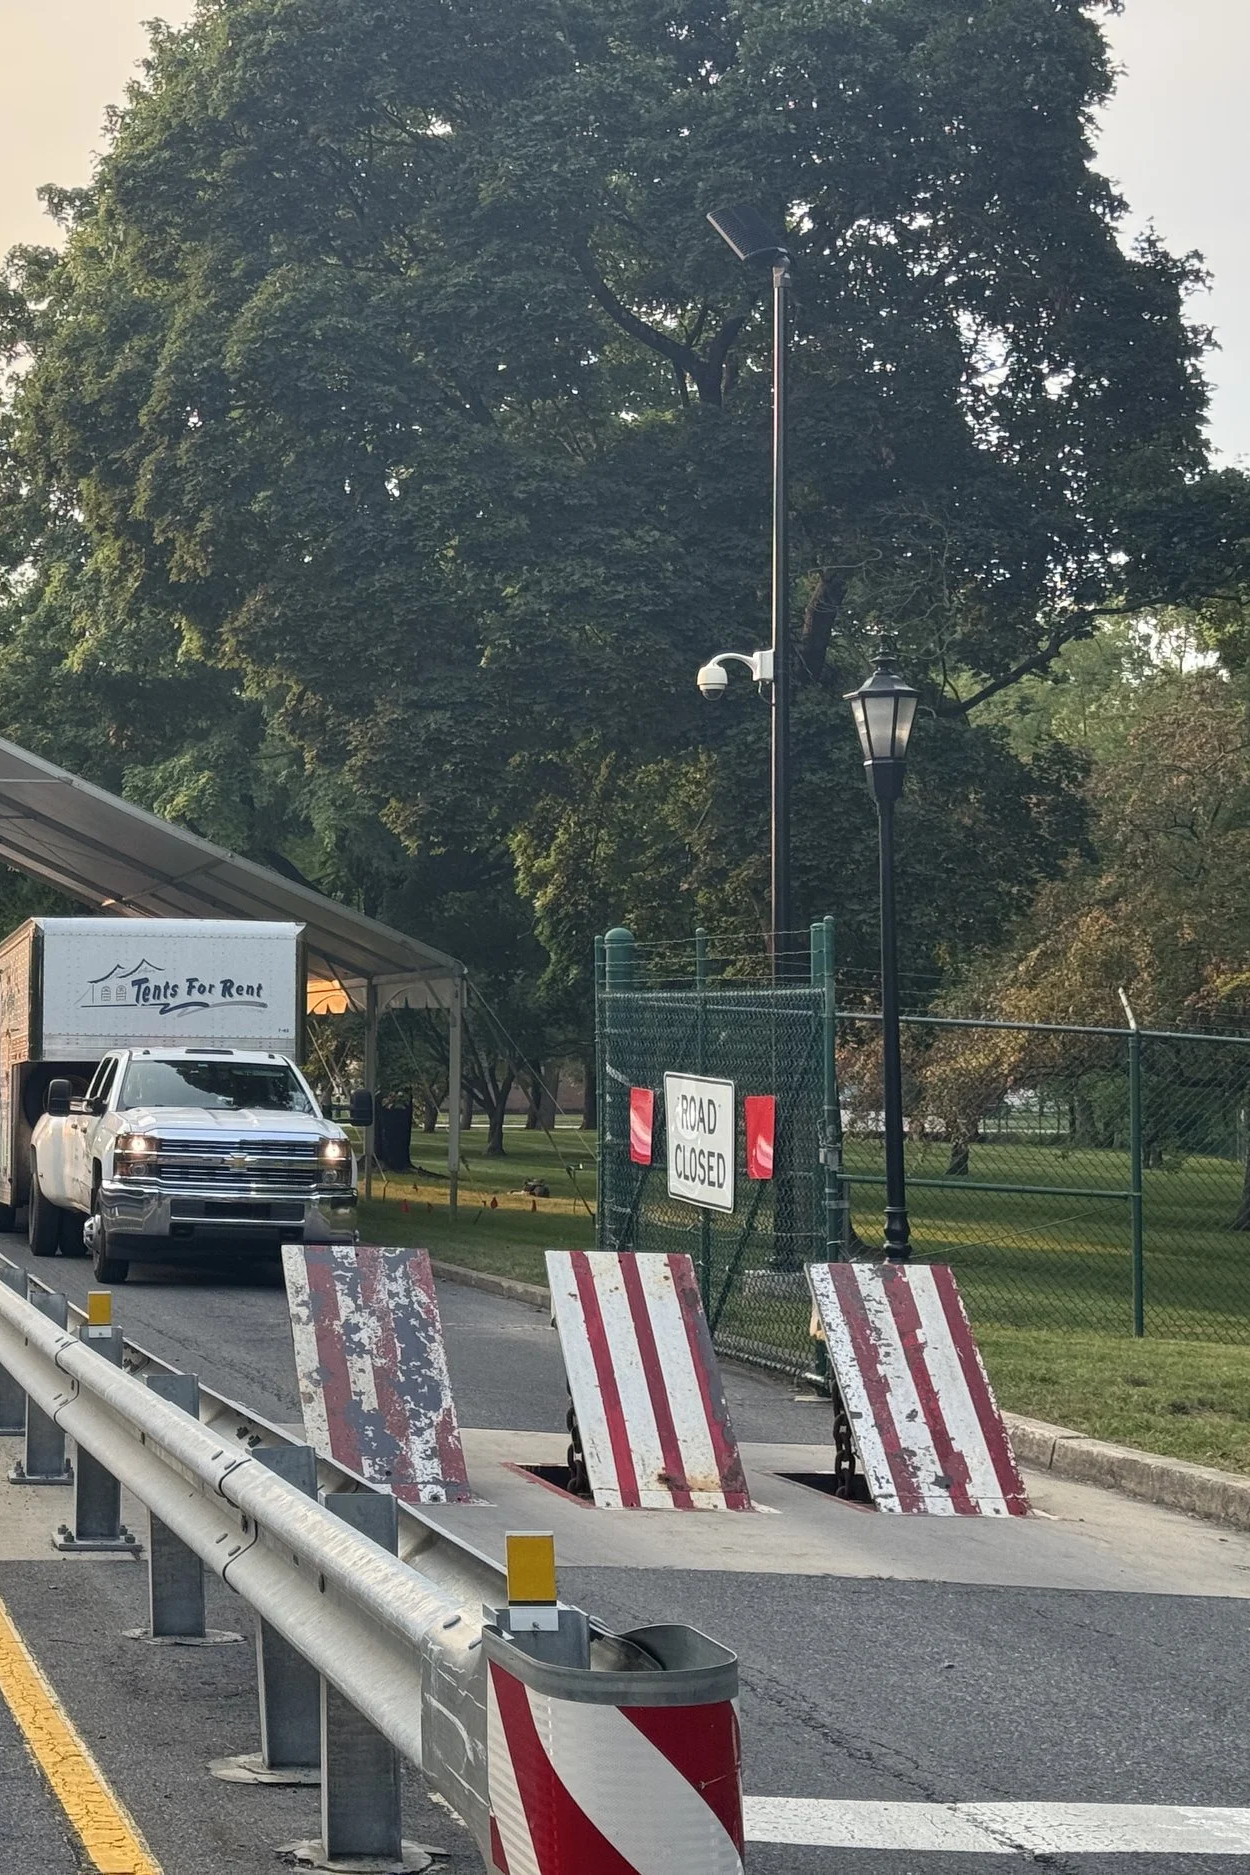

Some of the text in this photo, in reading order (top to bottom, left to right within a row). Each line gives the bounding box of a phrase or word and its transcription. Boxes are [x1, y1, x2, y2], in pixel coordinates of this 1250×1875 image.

[131, 977, 263, 1004] Tents For Rent
[681, 1094, 717, 1135] ROAD
[674, 1143, 726, 1189] CLOSED
